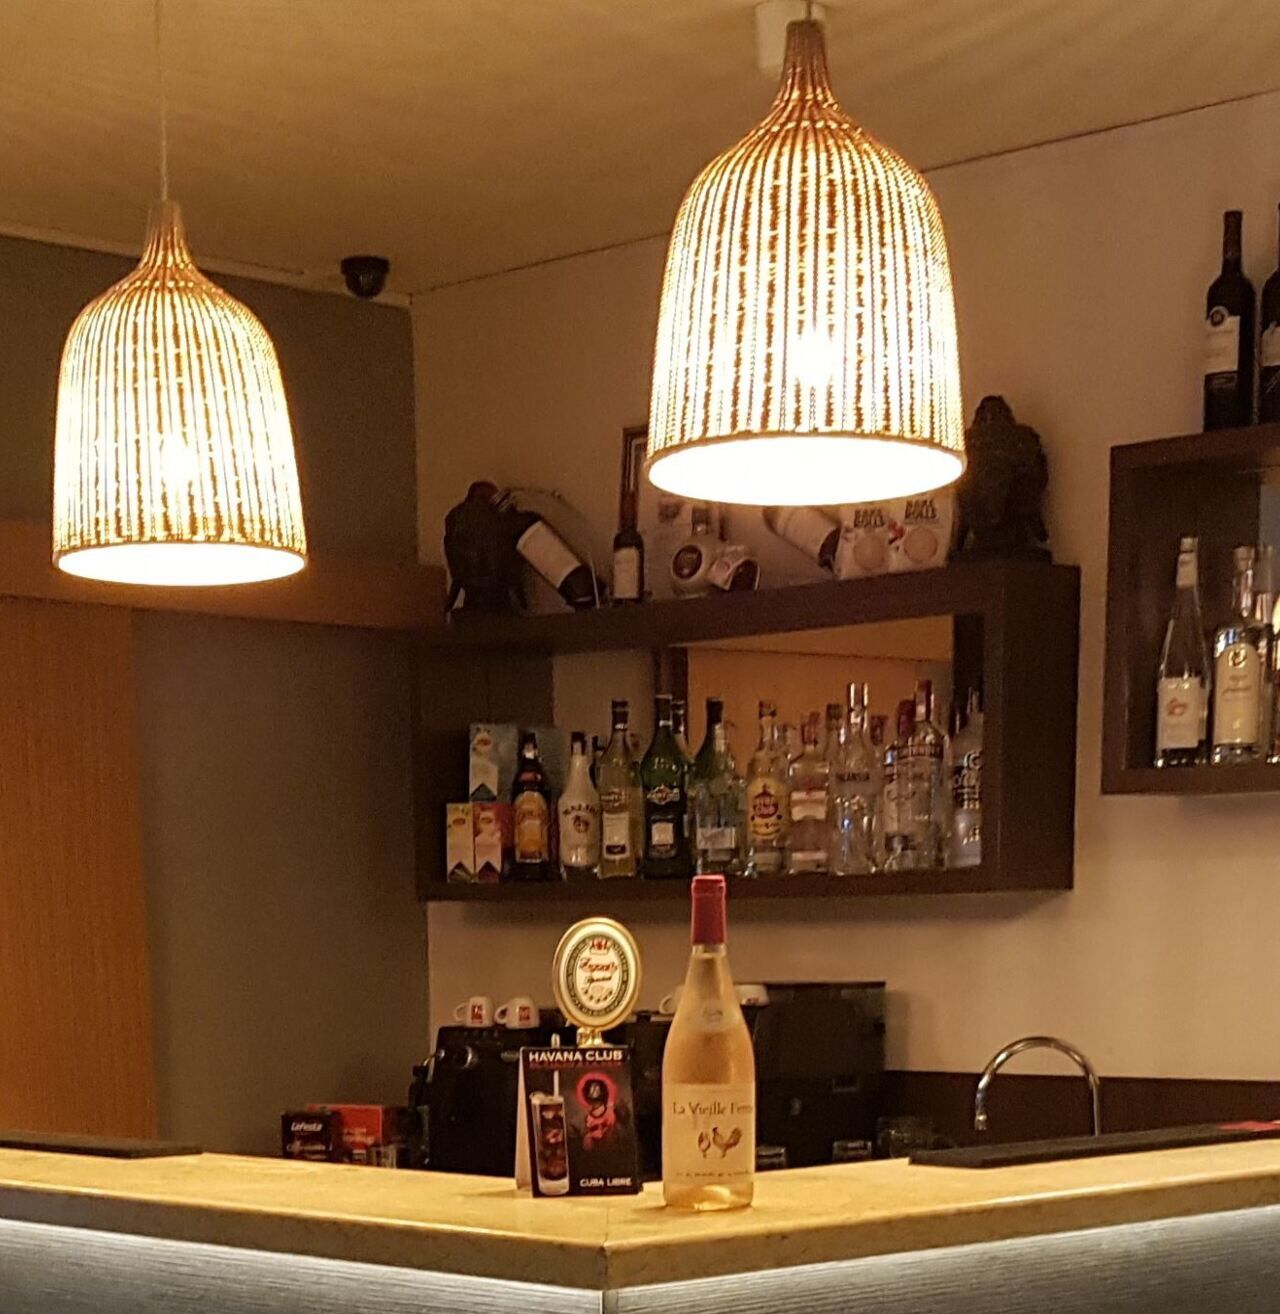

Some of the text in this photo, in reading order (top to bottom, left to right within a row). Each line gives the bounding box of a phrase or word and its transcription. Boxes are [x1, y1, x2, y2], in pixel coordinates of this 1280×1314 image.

[529, 1050, 623, 1062] HAVANA CLUB
[673, 1101, 686, 1114] La
[579, 1177, 632, 1187] CUBA LIBRE
